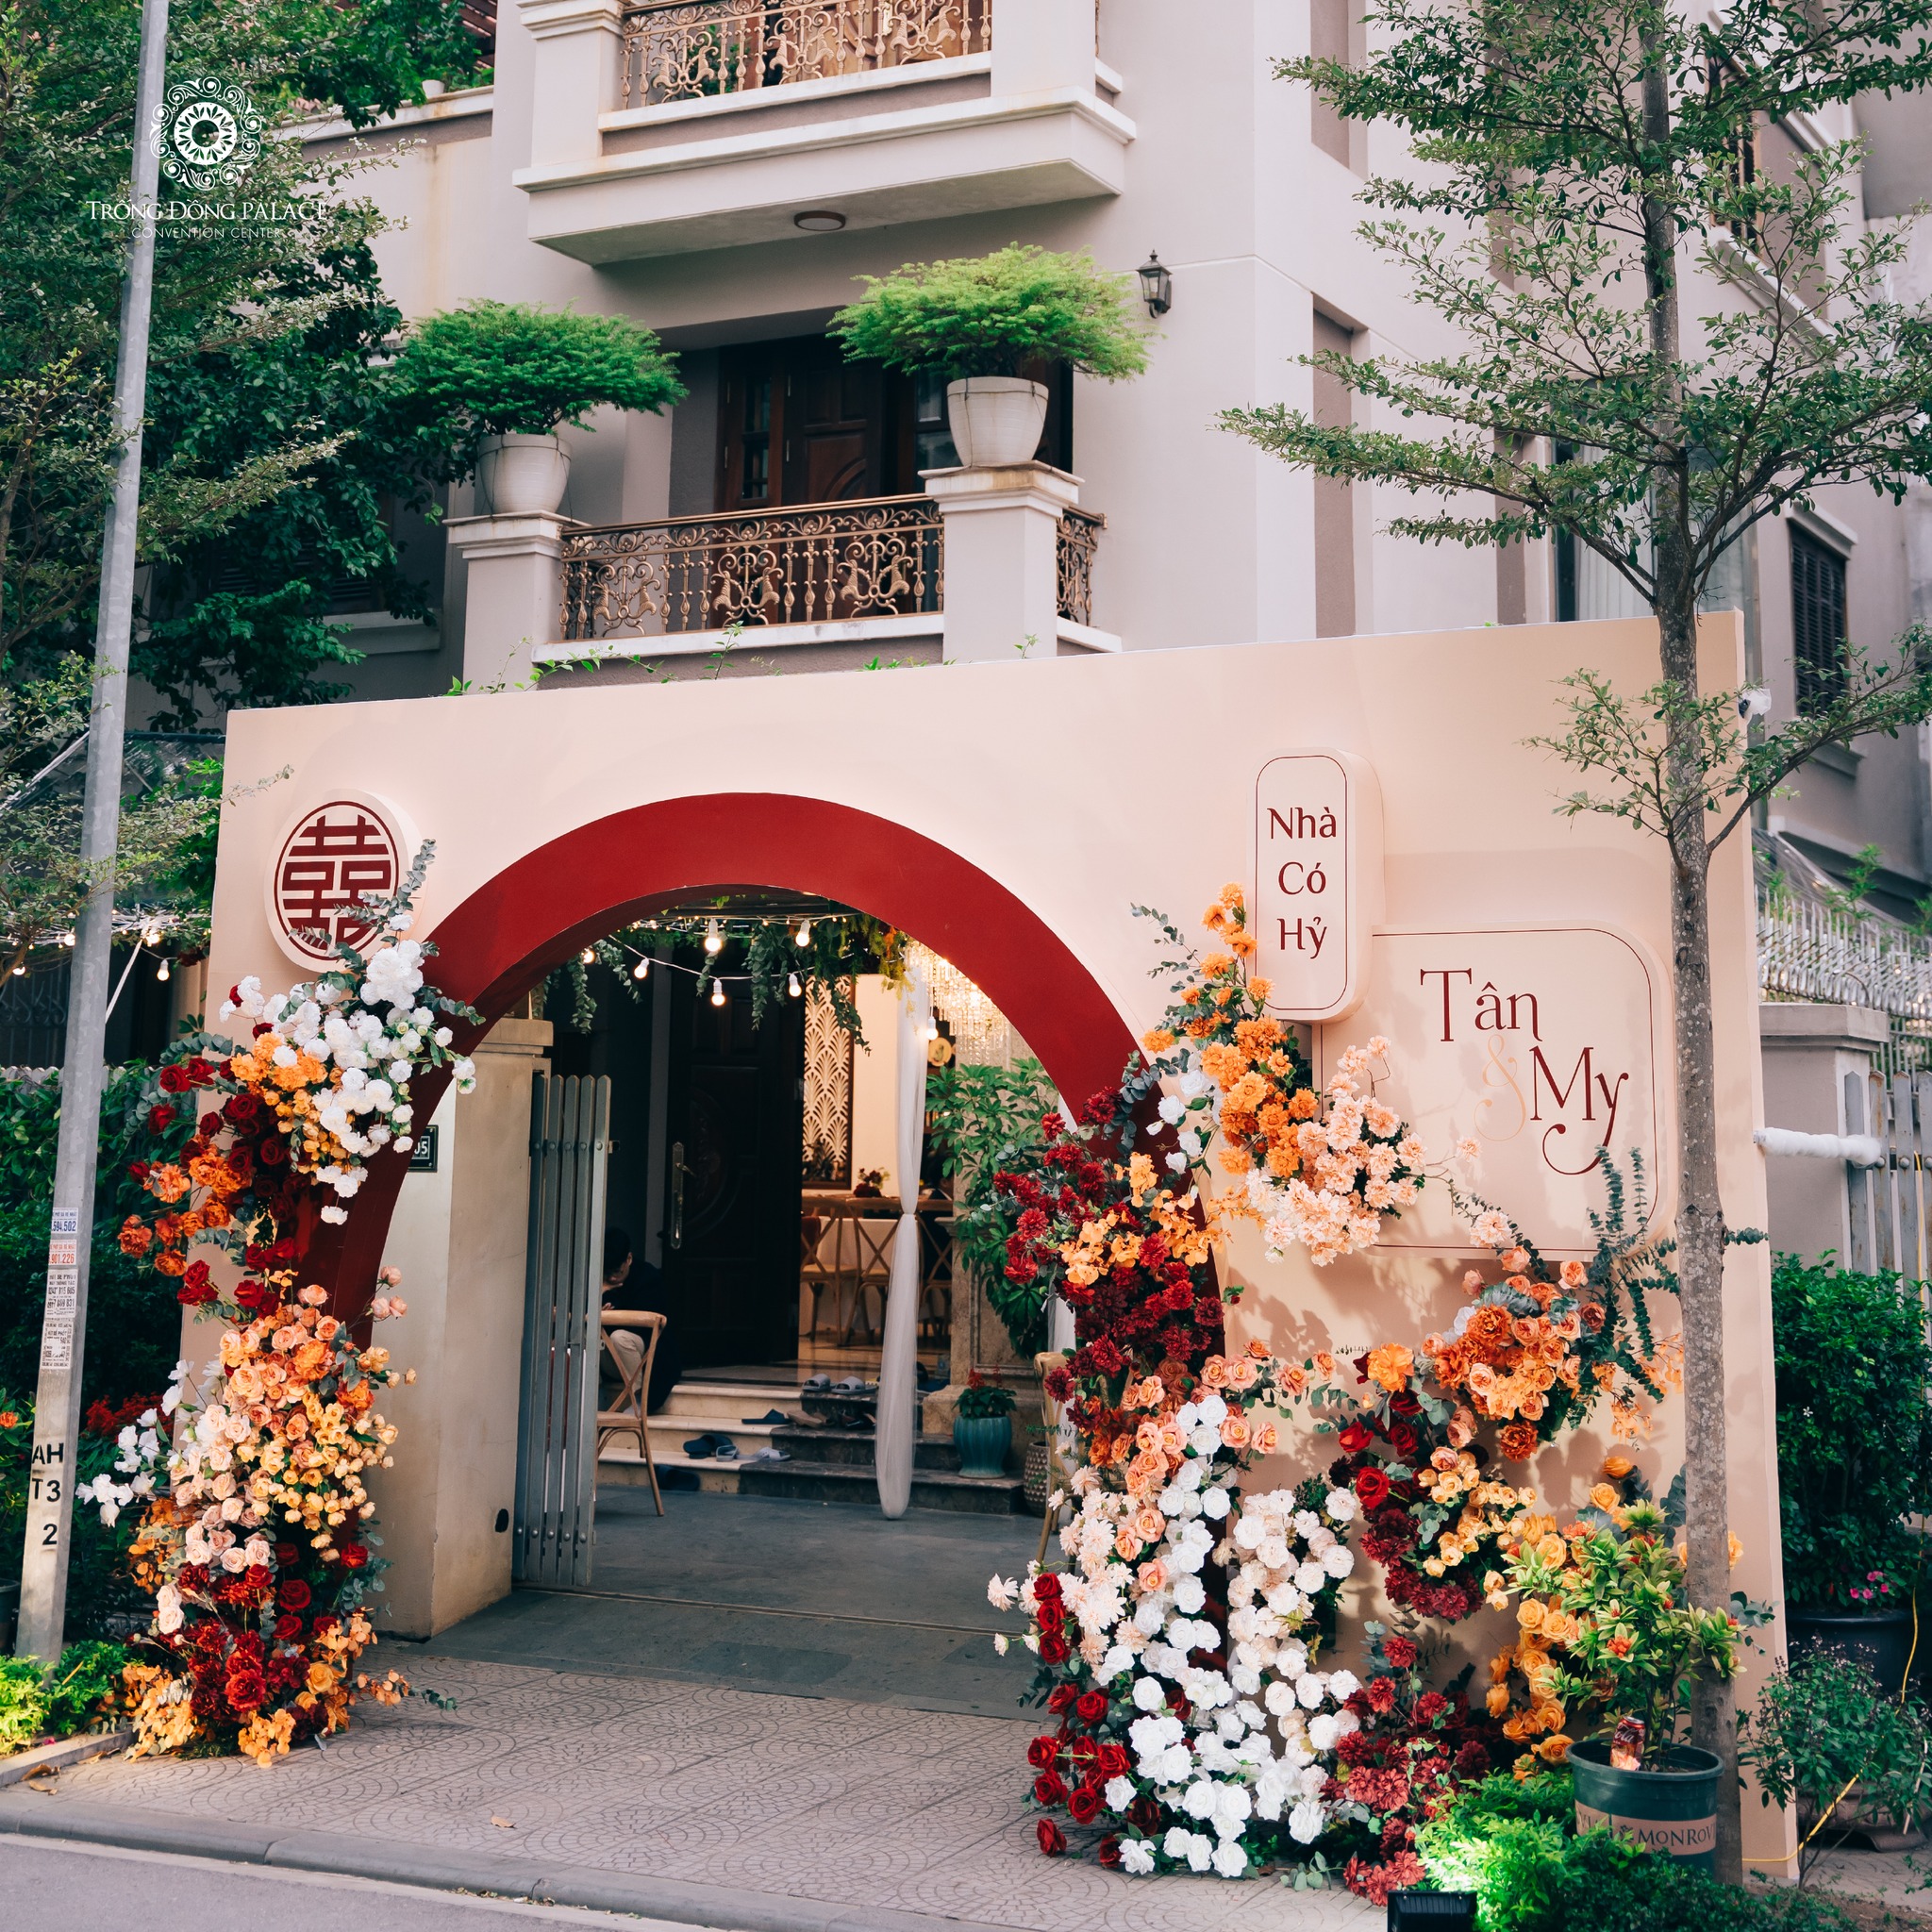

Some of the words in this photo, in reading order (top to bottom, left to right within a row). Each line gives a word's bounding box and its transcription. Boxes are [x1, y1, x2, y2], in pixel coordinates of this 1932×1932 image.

[1267, 807, 1337, 840] Nhà
[1278, 861, 1326, 895] Có
[1276, 916, 1327, 959] Hỷ
[1420, 968, 1542, 1042] Tân
[1474, 1034, 1526, 1141] &
[1529, 1045, 1629, 1175] My
[32, 1442, 64, 1464] AH
[31, 1478, 60, 1502] T3
[42, 1524, 58, 1545] 2
